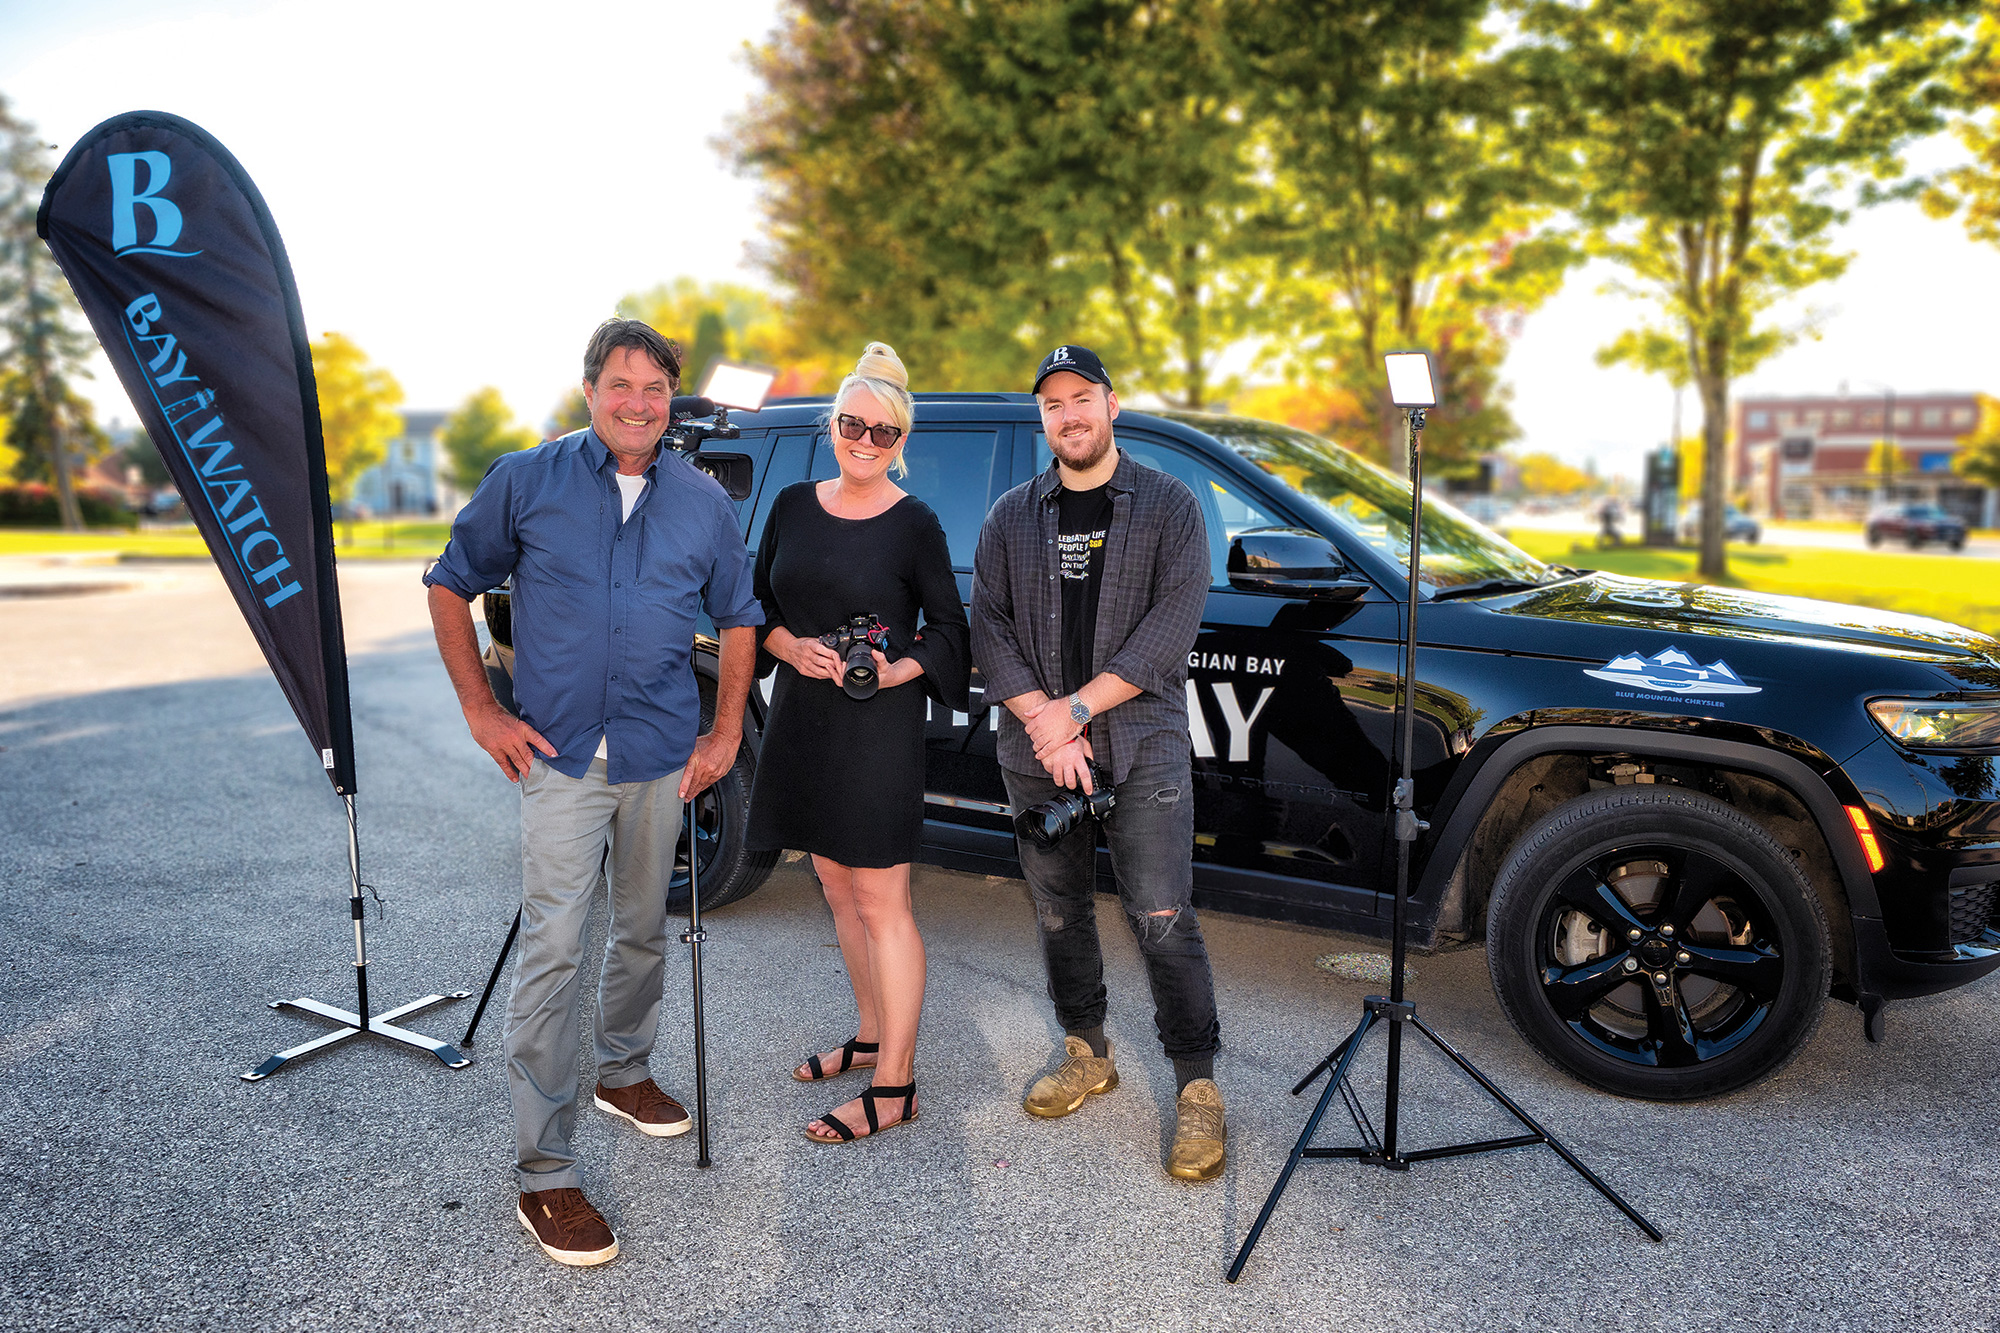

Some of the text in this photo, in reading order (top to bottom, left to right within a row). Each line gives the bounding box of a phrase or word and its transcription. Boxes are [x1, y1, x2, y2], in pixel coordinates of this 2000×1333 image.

[107, 150, 183, 252] B
[1053, 346, 1069, 363] B
[125, 292, 304, 609] BAY WATCH
[1092, 530, 1106, 539] LIFE
[1058, 543, 1084, 552] PEOPLE
[1245, 656, 1286, 676] BAY
[1615, 691, 1726, 708] BLUE MOUNTAIN CHRYSLER
